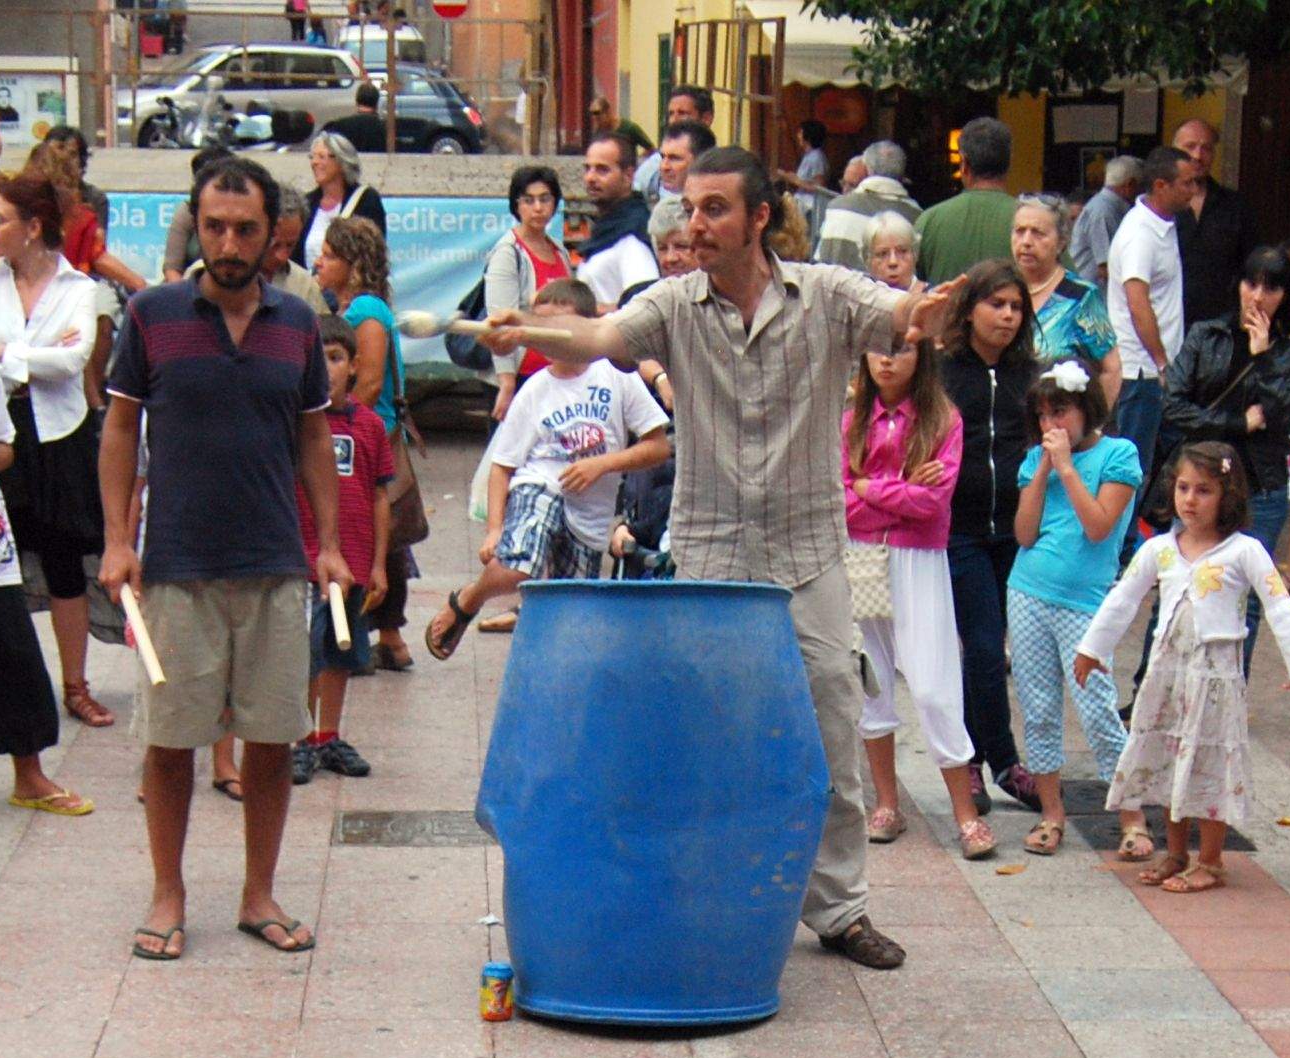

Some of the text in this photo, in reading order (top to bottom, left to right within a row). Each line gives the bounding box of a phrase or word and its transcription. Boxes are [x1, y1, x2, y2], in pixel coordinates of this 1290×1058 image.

[108, 201, 146, 228] ola
[386, 208, 515, 233] editerran
[586, 385, 613, 404] 76
[541, 402, 610, 430] ROARING
